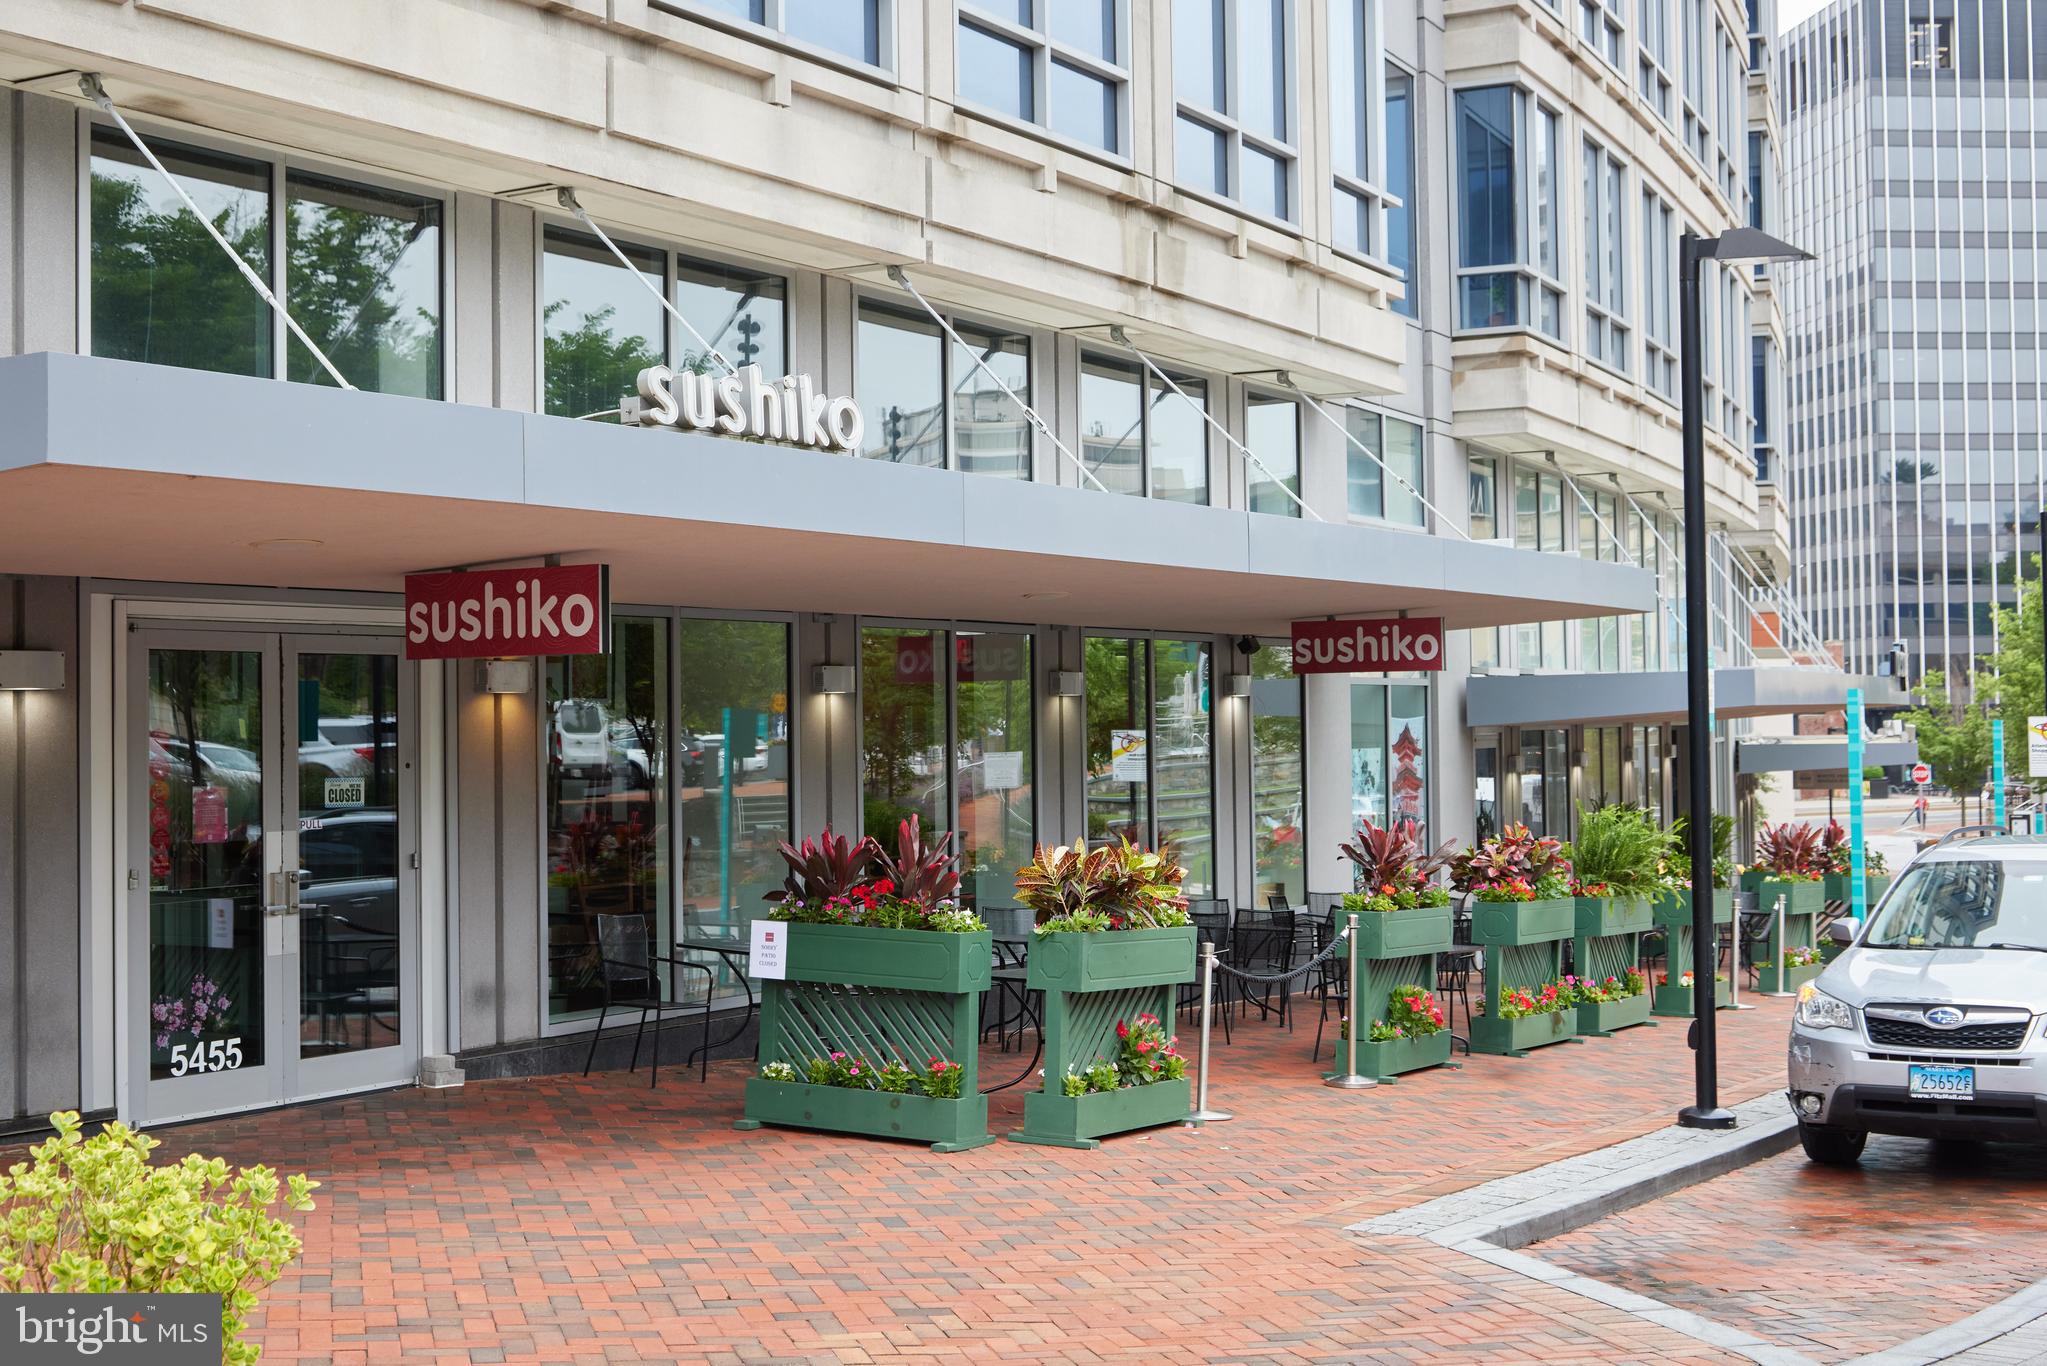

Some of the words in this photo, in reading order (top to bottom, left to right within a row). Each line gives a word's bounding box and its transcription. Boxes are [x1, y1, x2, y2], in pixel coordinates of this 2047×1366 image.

[636, 362, 865, 450] sushiko
[409, 578, 594, 644] sushiko
[1295, 625, 1439, 664] sushiko
[328, 788, 361, 803] CLOSED
[300, 820, 322, 829] PULL
[170, 1037, 243, 1077] 5455
